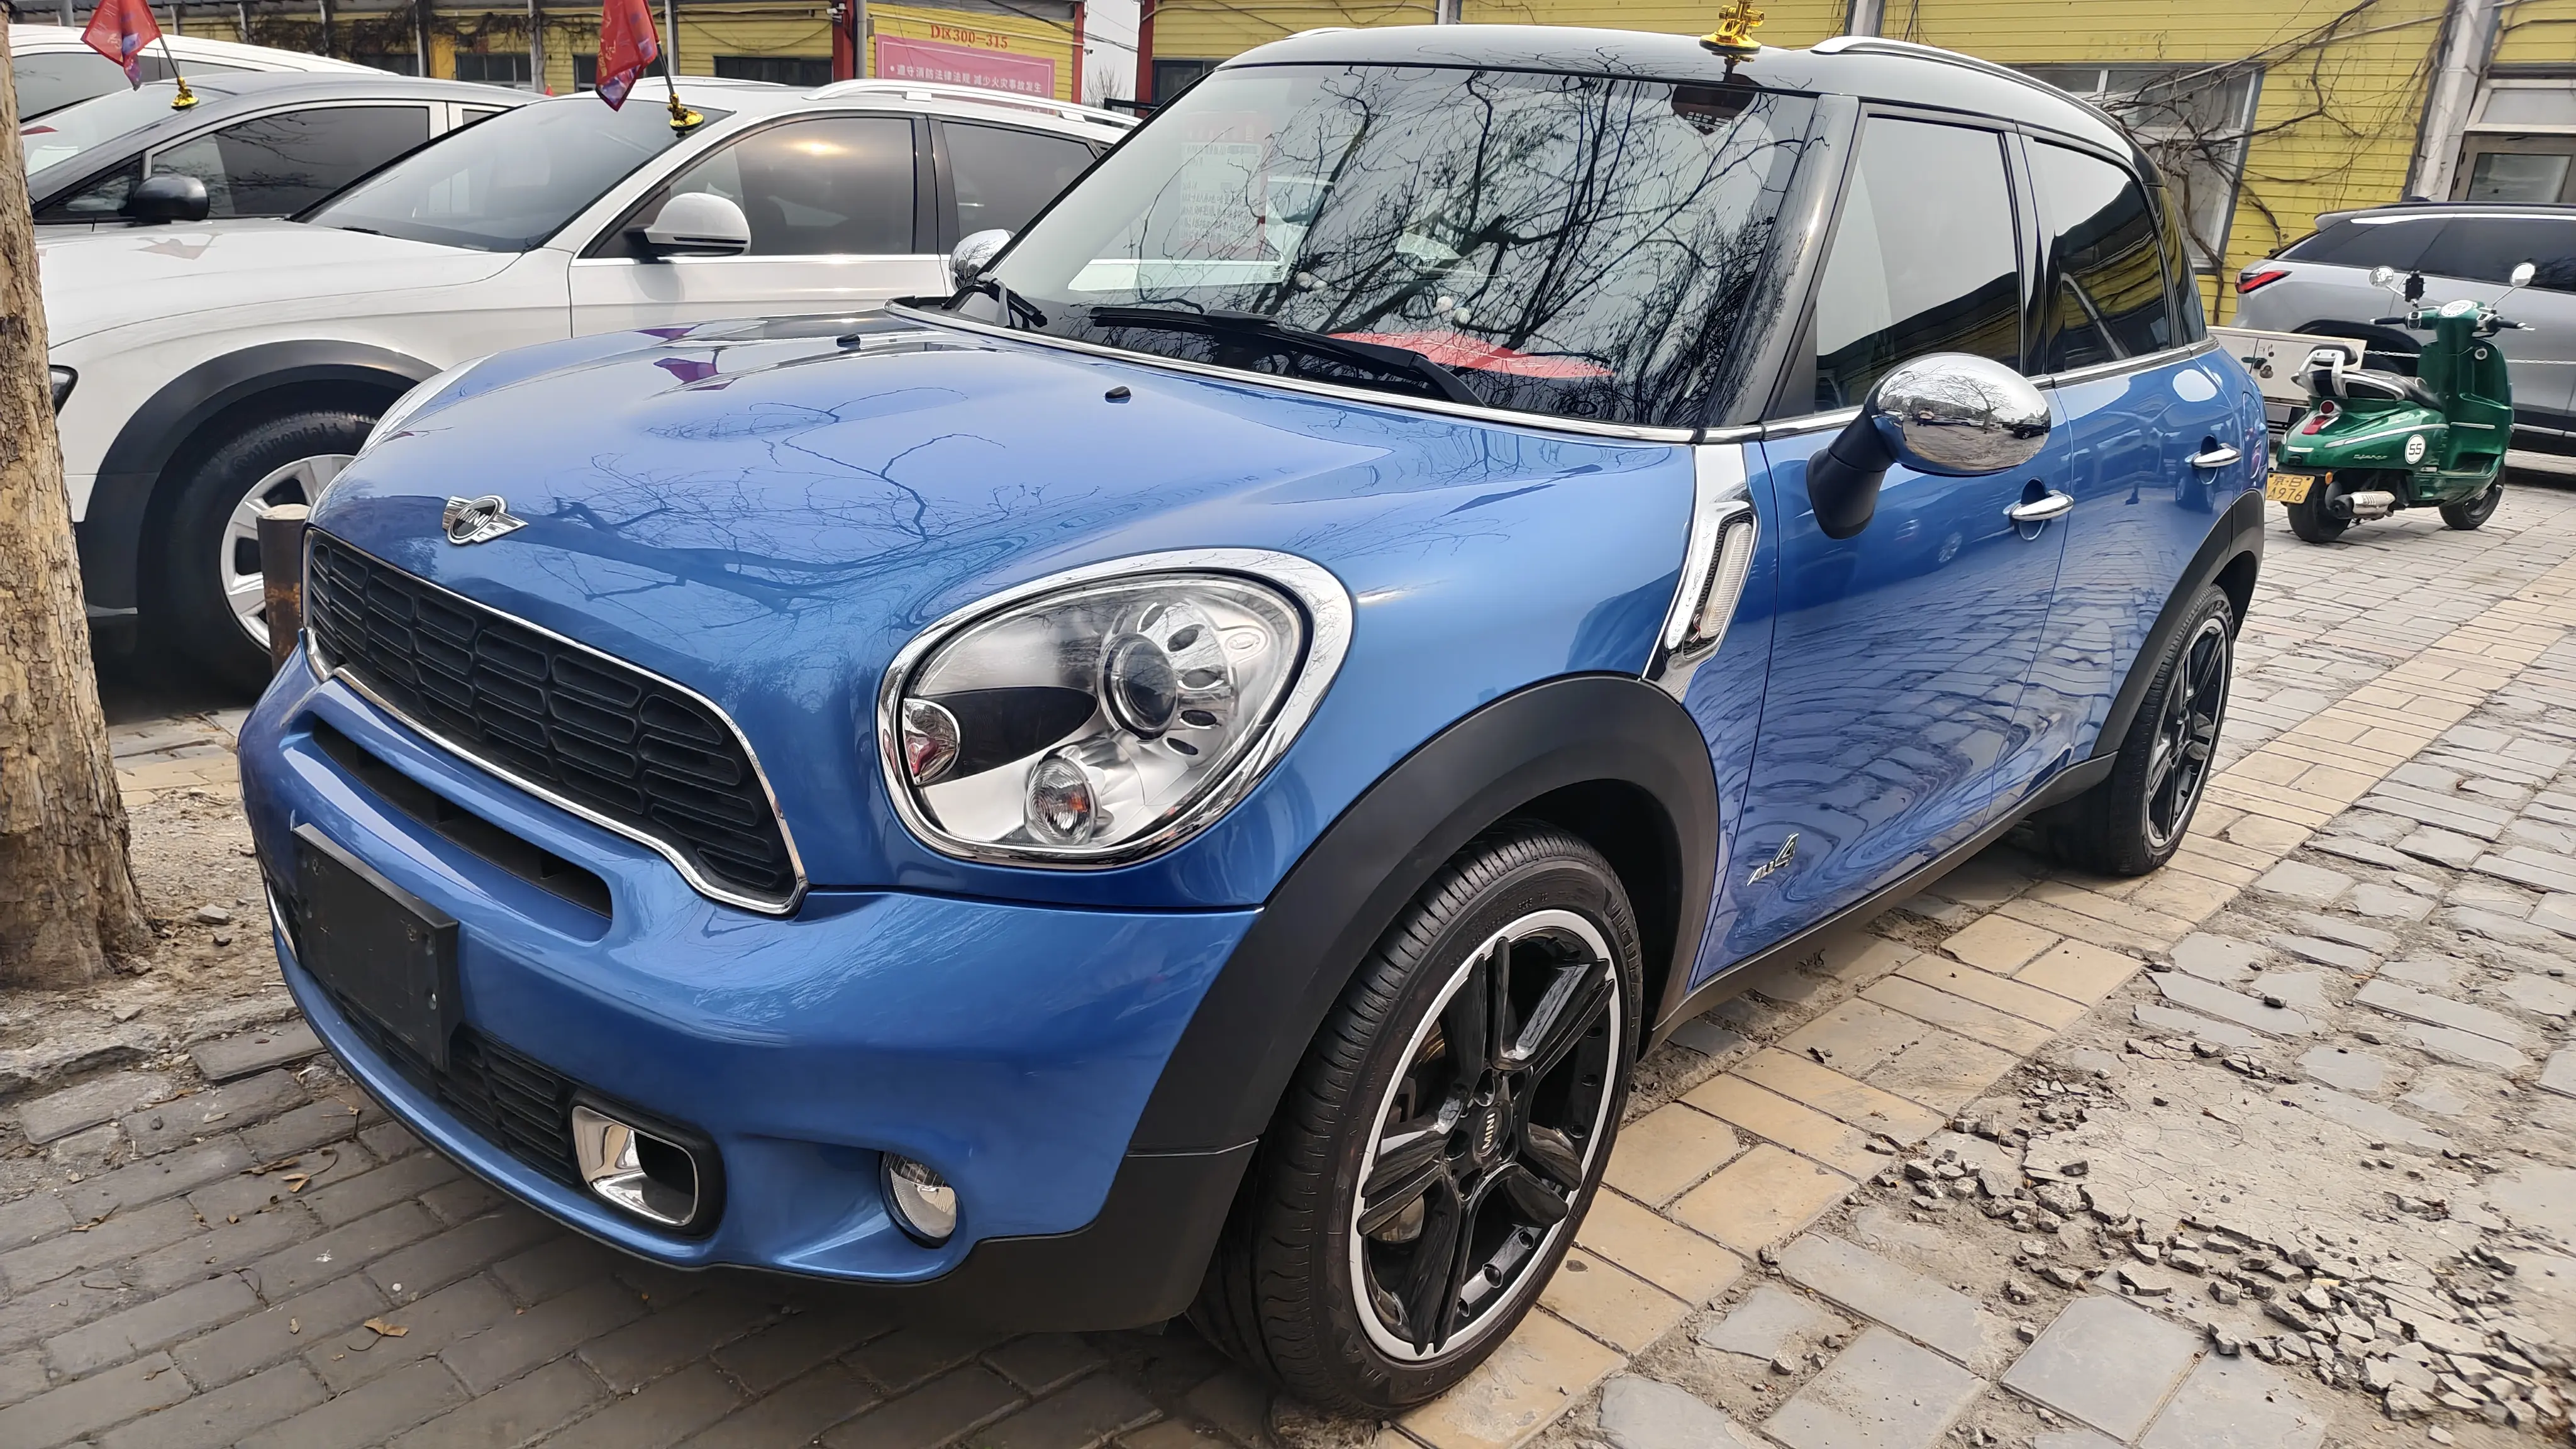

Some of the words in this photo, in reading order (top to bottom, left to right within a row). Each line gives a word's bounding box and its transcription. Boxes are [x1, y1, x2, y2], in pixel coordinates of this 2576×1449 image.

[897, 64, 971, 84] 遵守消防法律法规
[974, 75, 1042, 94] 减少火灾事故发生
[2408, 443, 2423, 455] 55
[457, 508, 490, 527] MINI
[1482, 1113, 1496, 1150] MINI
